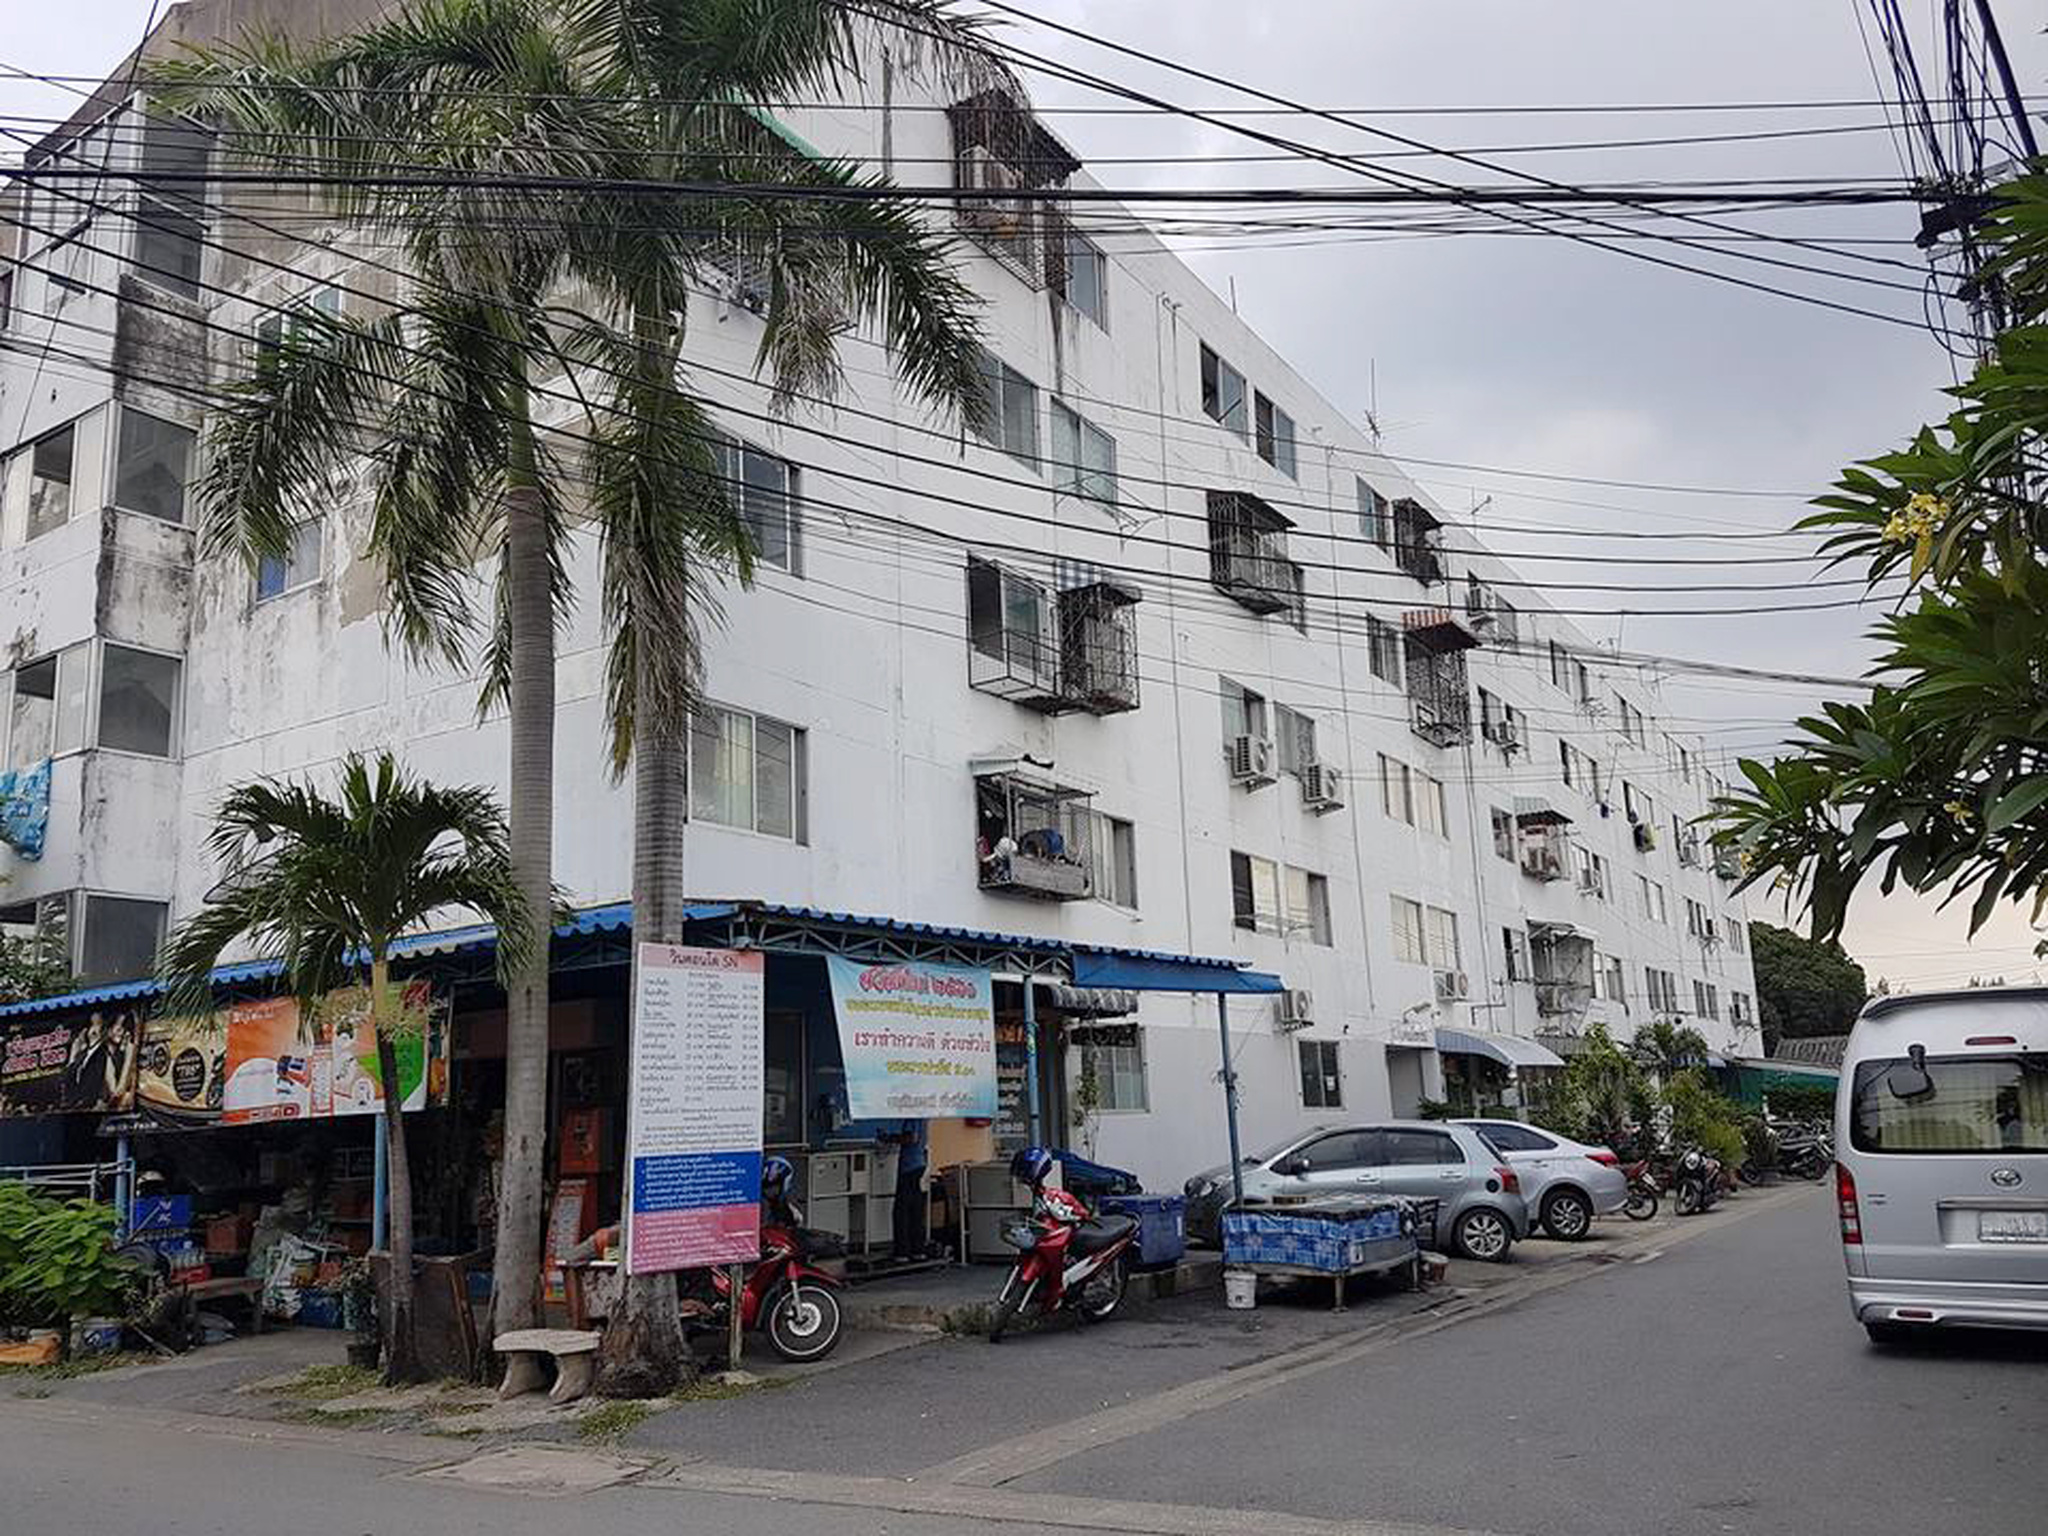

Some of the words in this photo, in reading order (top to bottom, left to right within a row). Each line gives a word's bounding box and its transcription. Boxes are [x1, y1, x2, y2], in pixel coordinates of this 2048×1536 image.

[854, 1027, 935, 1050] เราทำความดี
